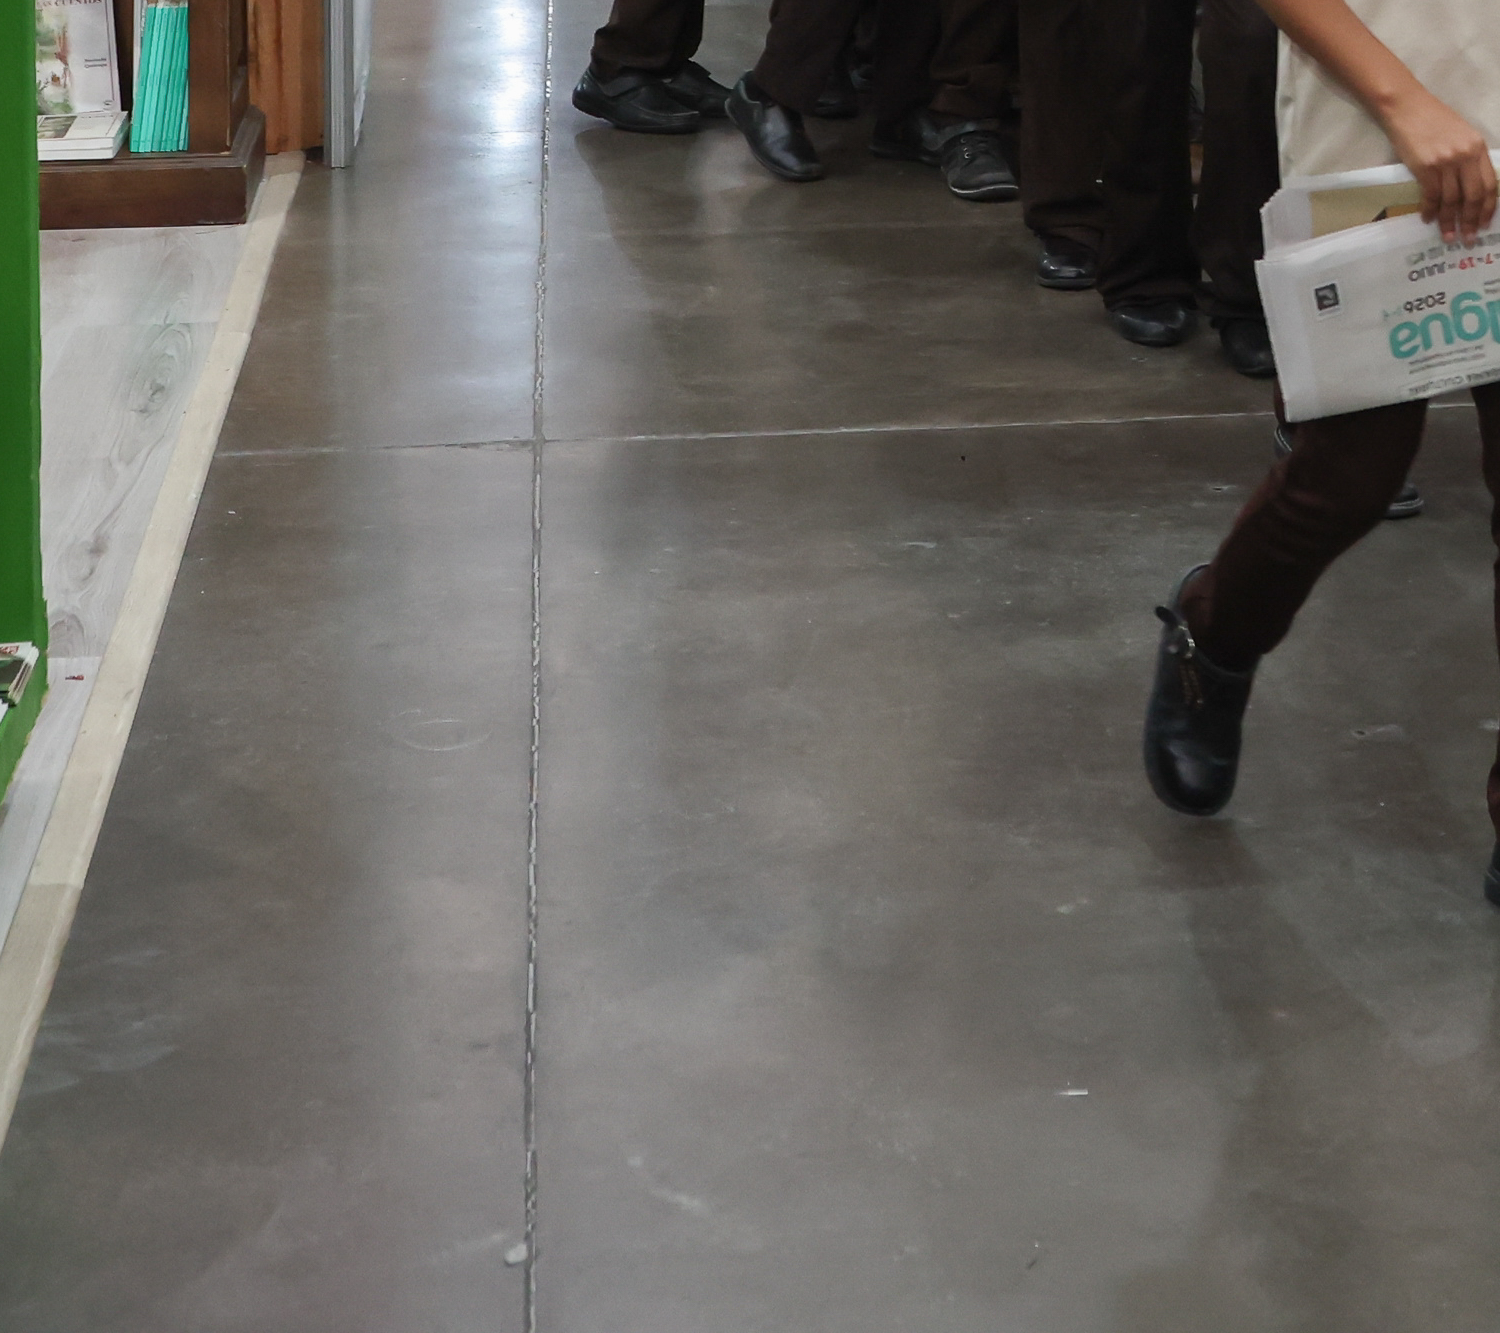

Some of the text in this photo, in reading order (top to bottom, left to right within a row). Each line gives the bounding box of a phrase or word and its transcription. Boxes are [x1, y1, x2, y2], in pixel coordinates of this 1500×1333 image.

[1408, 259, 1446, 282] JULIO
[1457, 254, 1477, 270] 19
[1403, 292, 1447, 312] 2026
